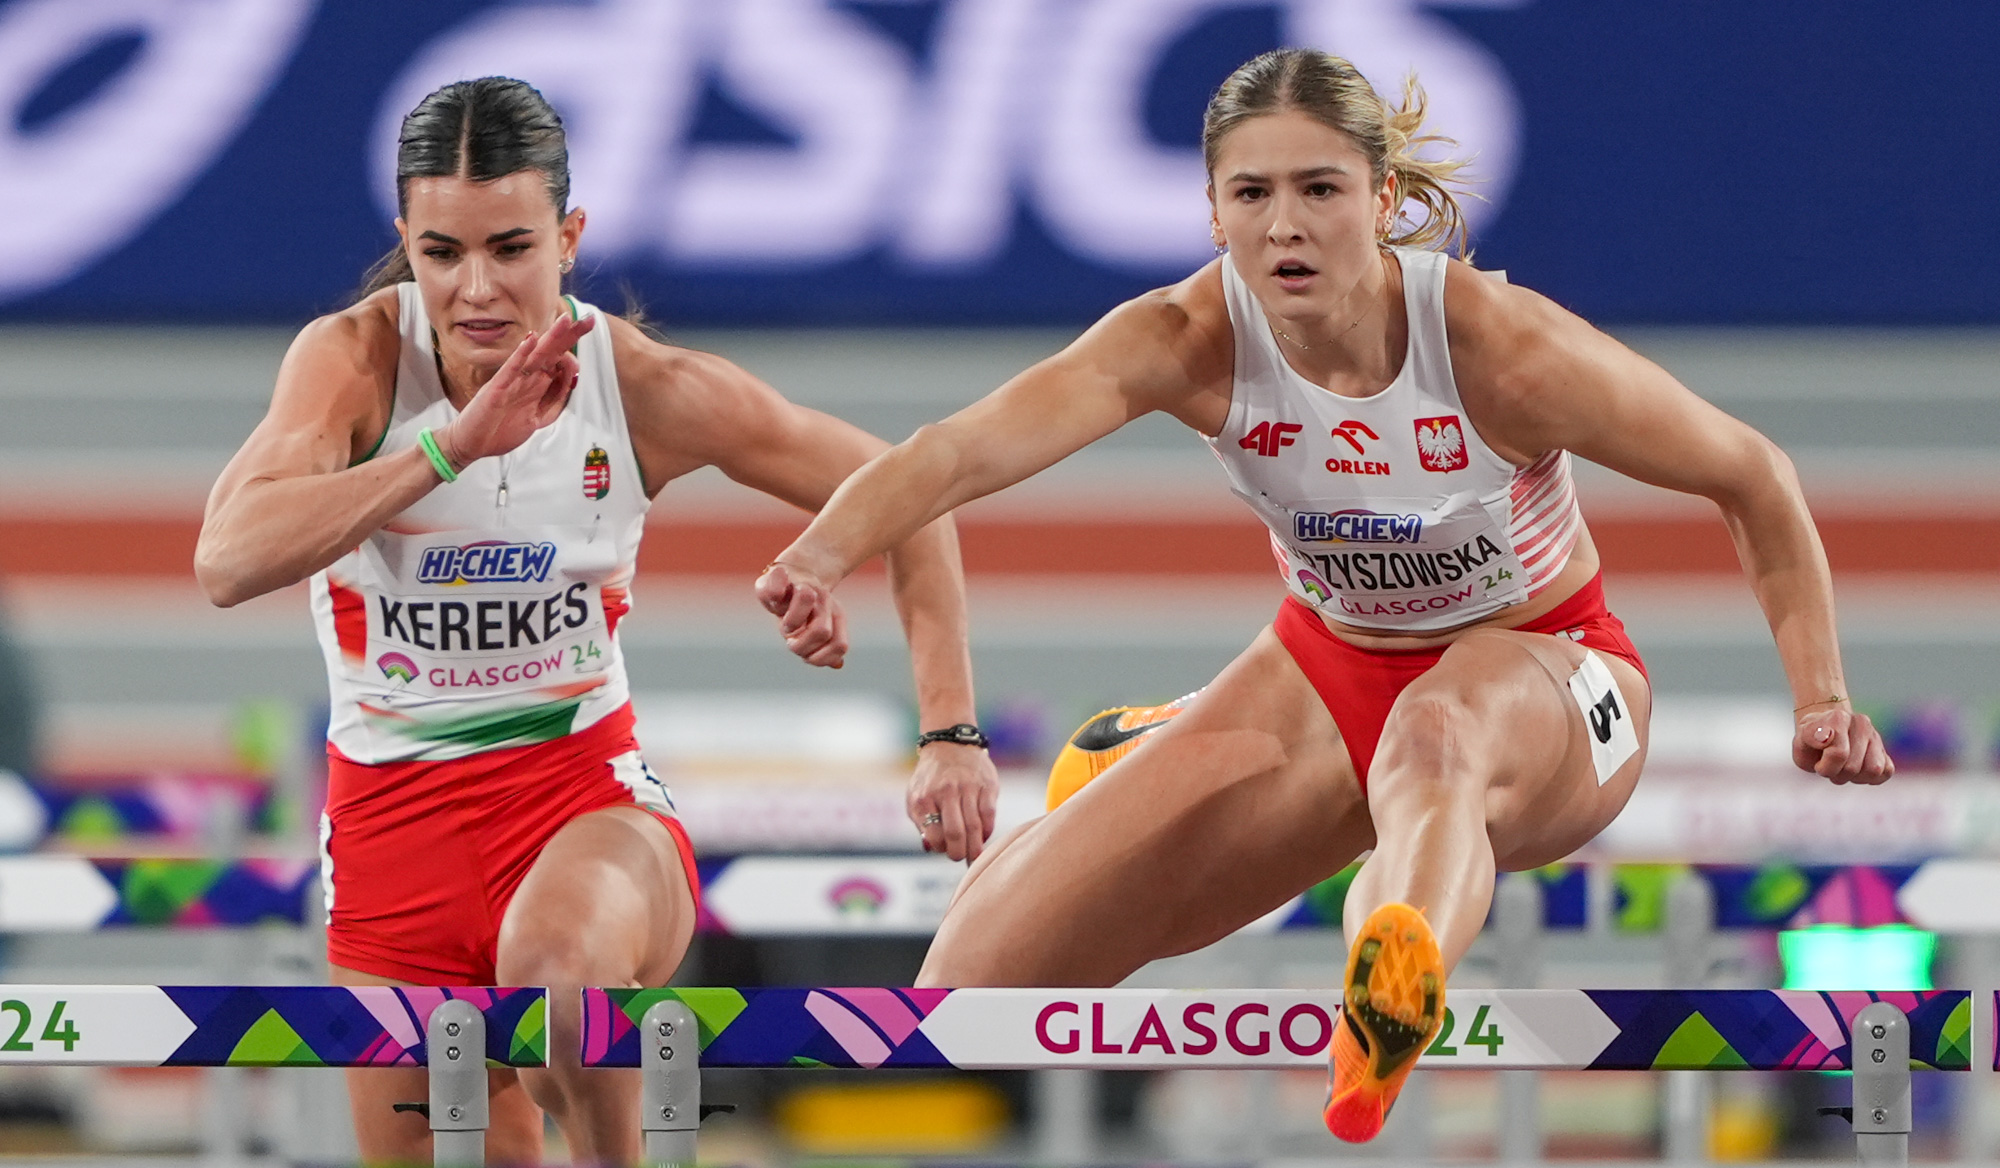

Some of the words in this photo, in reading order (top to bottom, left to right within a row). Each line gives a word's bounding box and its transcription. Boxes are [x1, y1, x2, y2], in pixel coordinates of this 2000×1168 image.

[1325, 458, 1390, 475] ORLEN
[1294, 511, 1422, 543] HI-CHEW
[416, 541, 556, 583] HI-CHEW
[1287, 534, 1502, 590] ZYSZOWSKA
[379, 582, 588, 650] KEREKES
[1340, 584, 1473, 615] GLASGOW
[1480, 567, 1513, 590] 24
[429, 650, 563, 687] GLASGOW
[571, 640, 601, 665] 24
[1589, 688, 1621, 744] 5
[0, 999, 80, 1052] 24
[1035, 1001, 1343, 1056] GLASGO
[1423, 1004, 1504, 1056] 24
